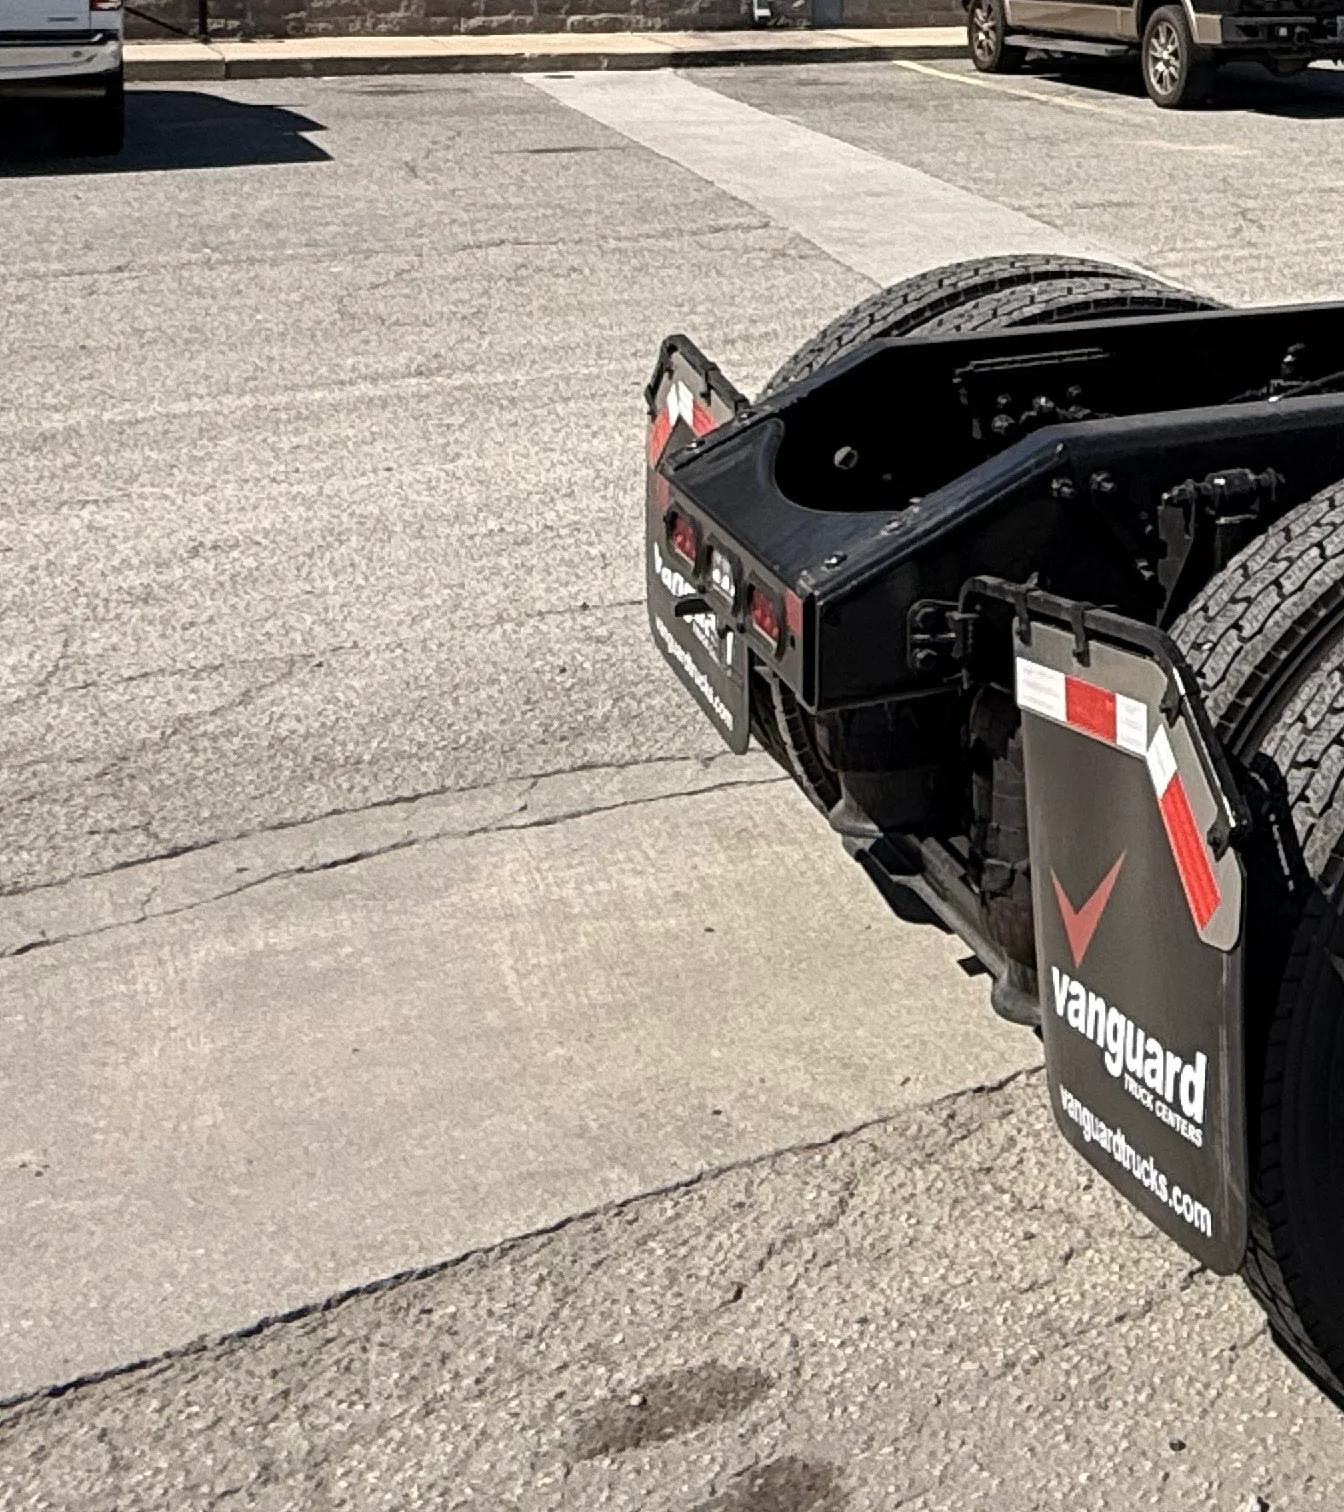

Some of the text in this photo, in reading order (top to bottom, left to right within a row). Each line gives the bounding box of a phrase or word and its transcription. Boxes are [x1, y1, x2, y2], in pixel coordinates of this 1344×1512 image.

[1051, 966, 1207, 1124] vanguard
[1124, 1071, 1203, 1149] TRUCK CENTERS
[1059, 1082, 1213, 1238] vanguardtrucks.com
